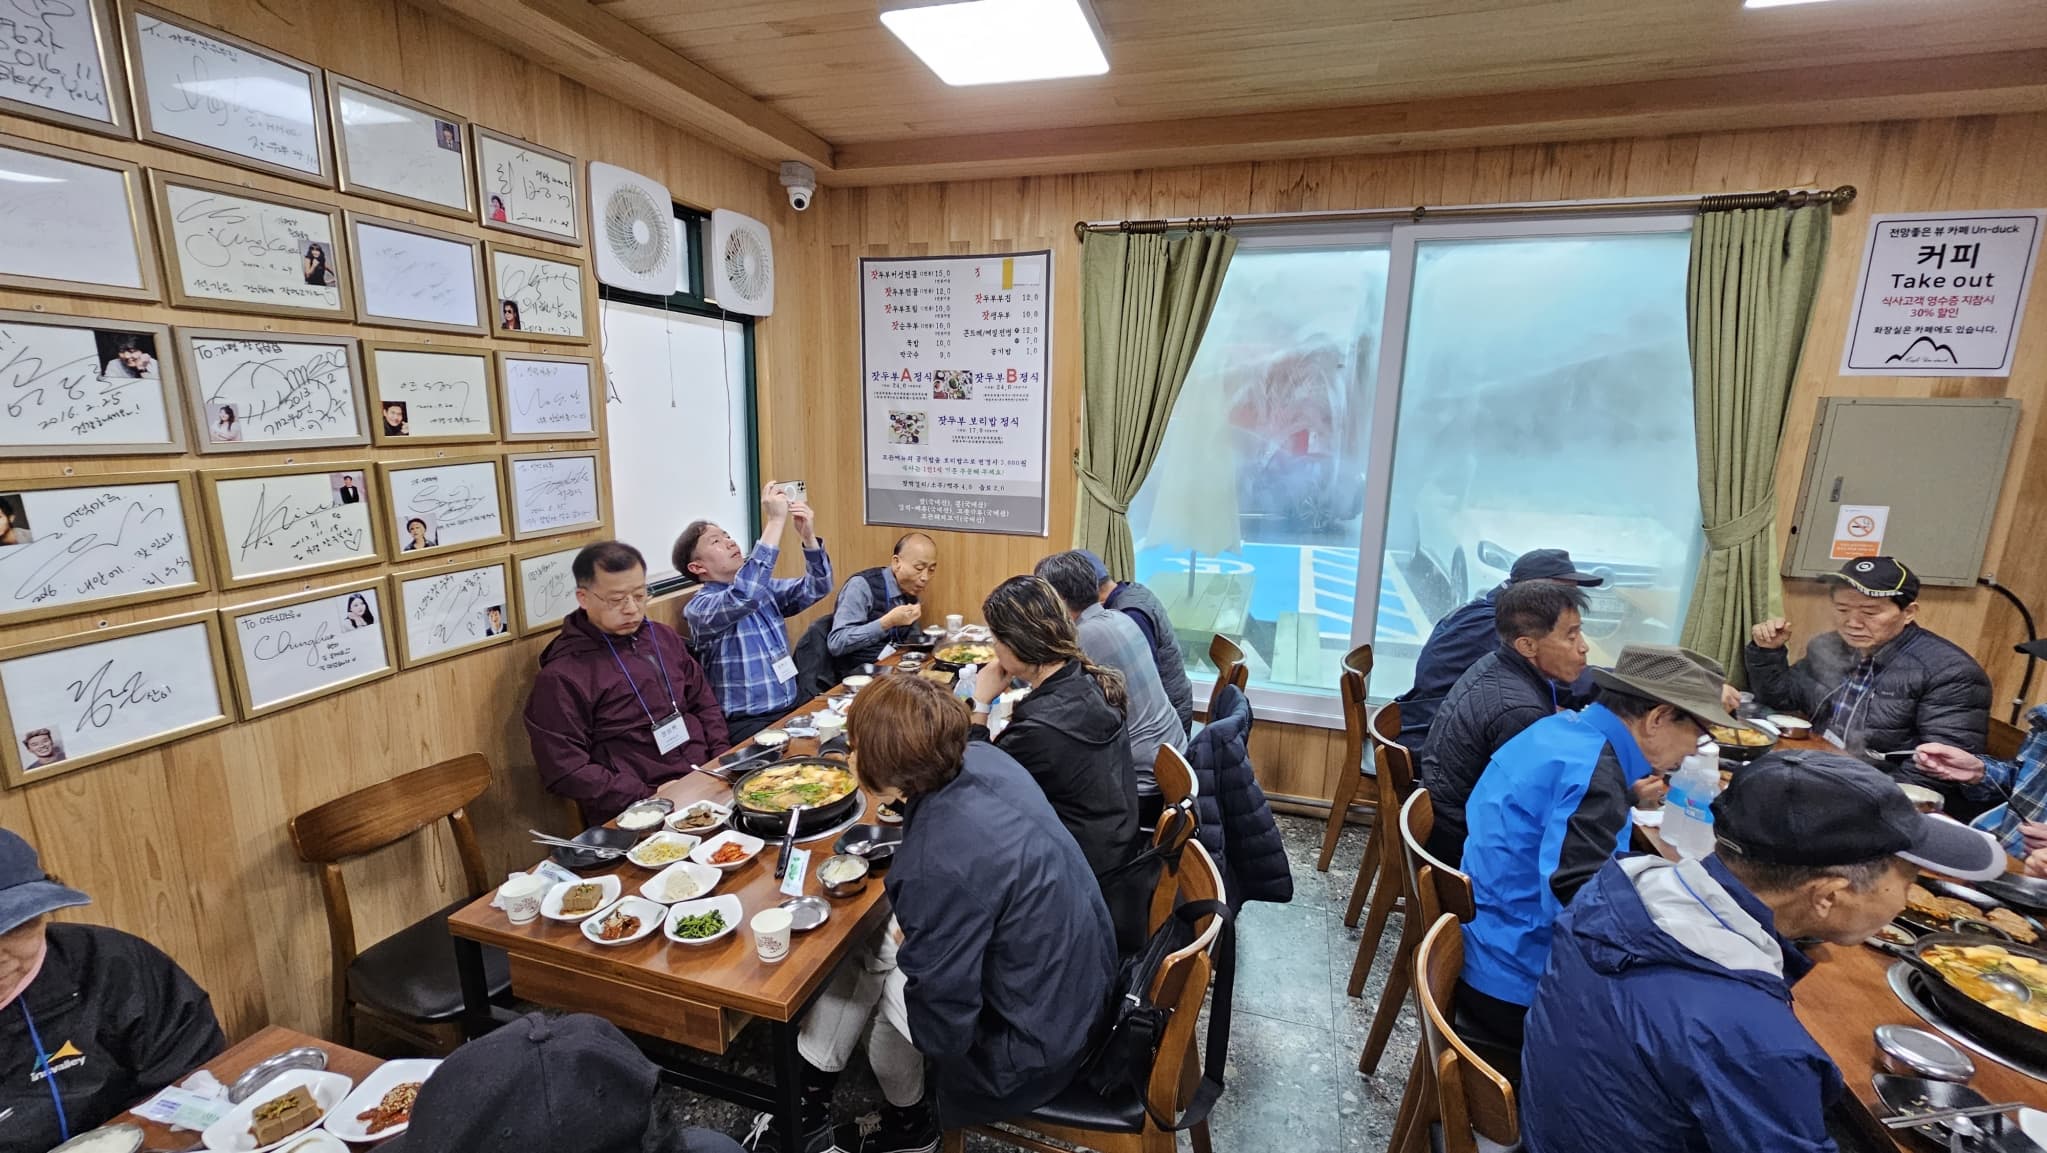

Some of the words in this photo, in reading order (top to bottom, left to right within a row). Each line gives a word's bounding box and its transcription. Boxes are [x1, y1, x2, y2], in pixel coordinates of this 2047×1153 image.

[1889, 227, 1932, 238] 전망좋은
[1934, 226, 1944, 237] 뷰
[1947, 225, 1970, 236] 카페
[1971, 225, 2020, 234] Un-duck
[1917, 243, 1980, 269] 커피
[1891, 273, 1946, 288] Take
[1953, 273, 1995, 288] out
[1881, 296, 1925, 306] 식사고객
[1927, 296, 1960, 306] 영수증
[1961, 295, 1995, 305] 지참시
[1910, 308, 1934, 317] 30%
[1937, 308, 1959, 318] 할인
[1873, 326, 1912, 334] 화장실은
[1914, 325, 1953, 334] 카페에도
[1955, 325, 1998, 334] 있습니다.
